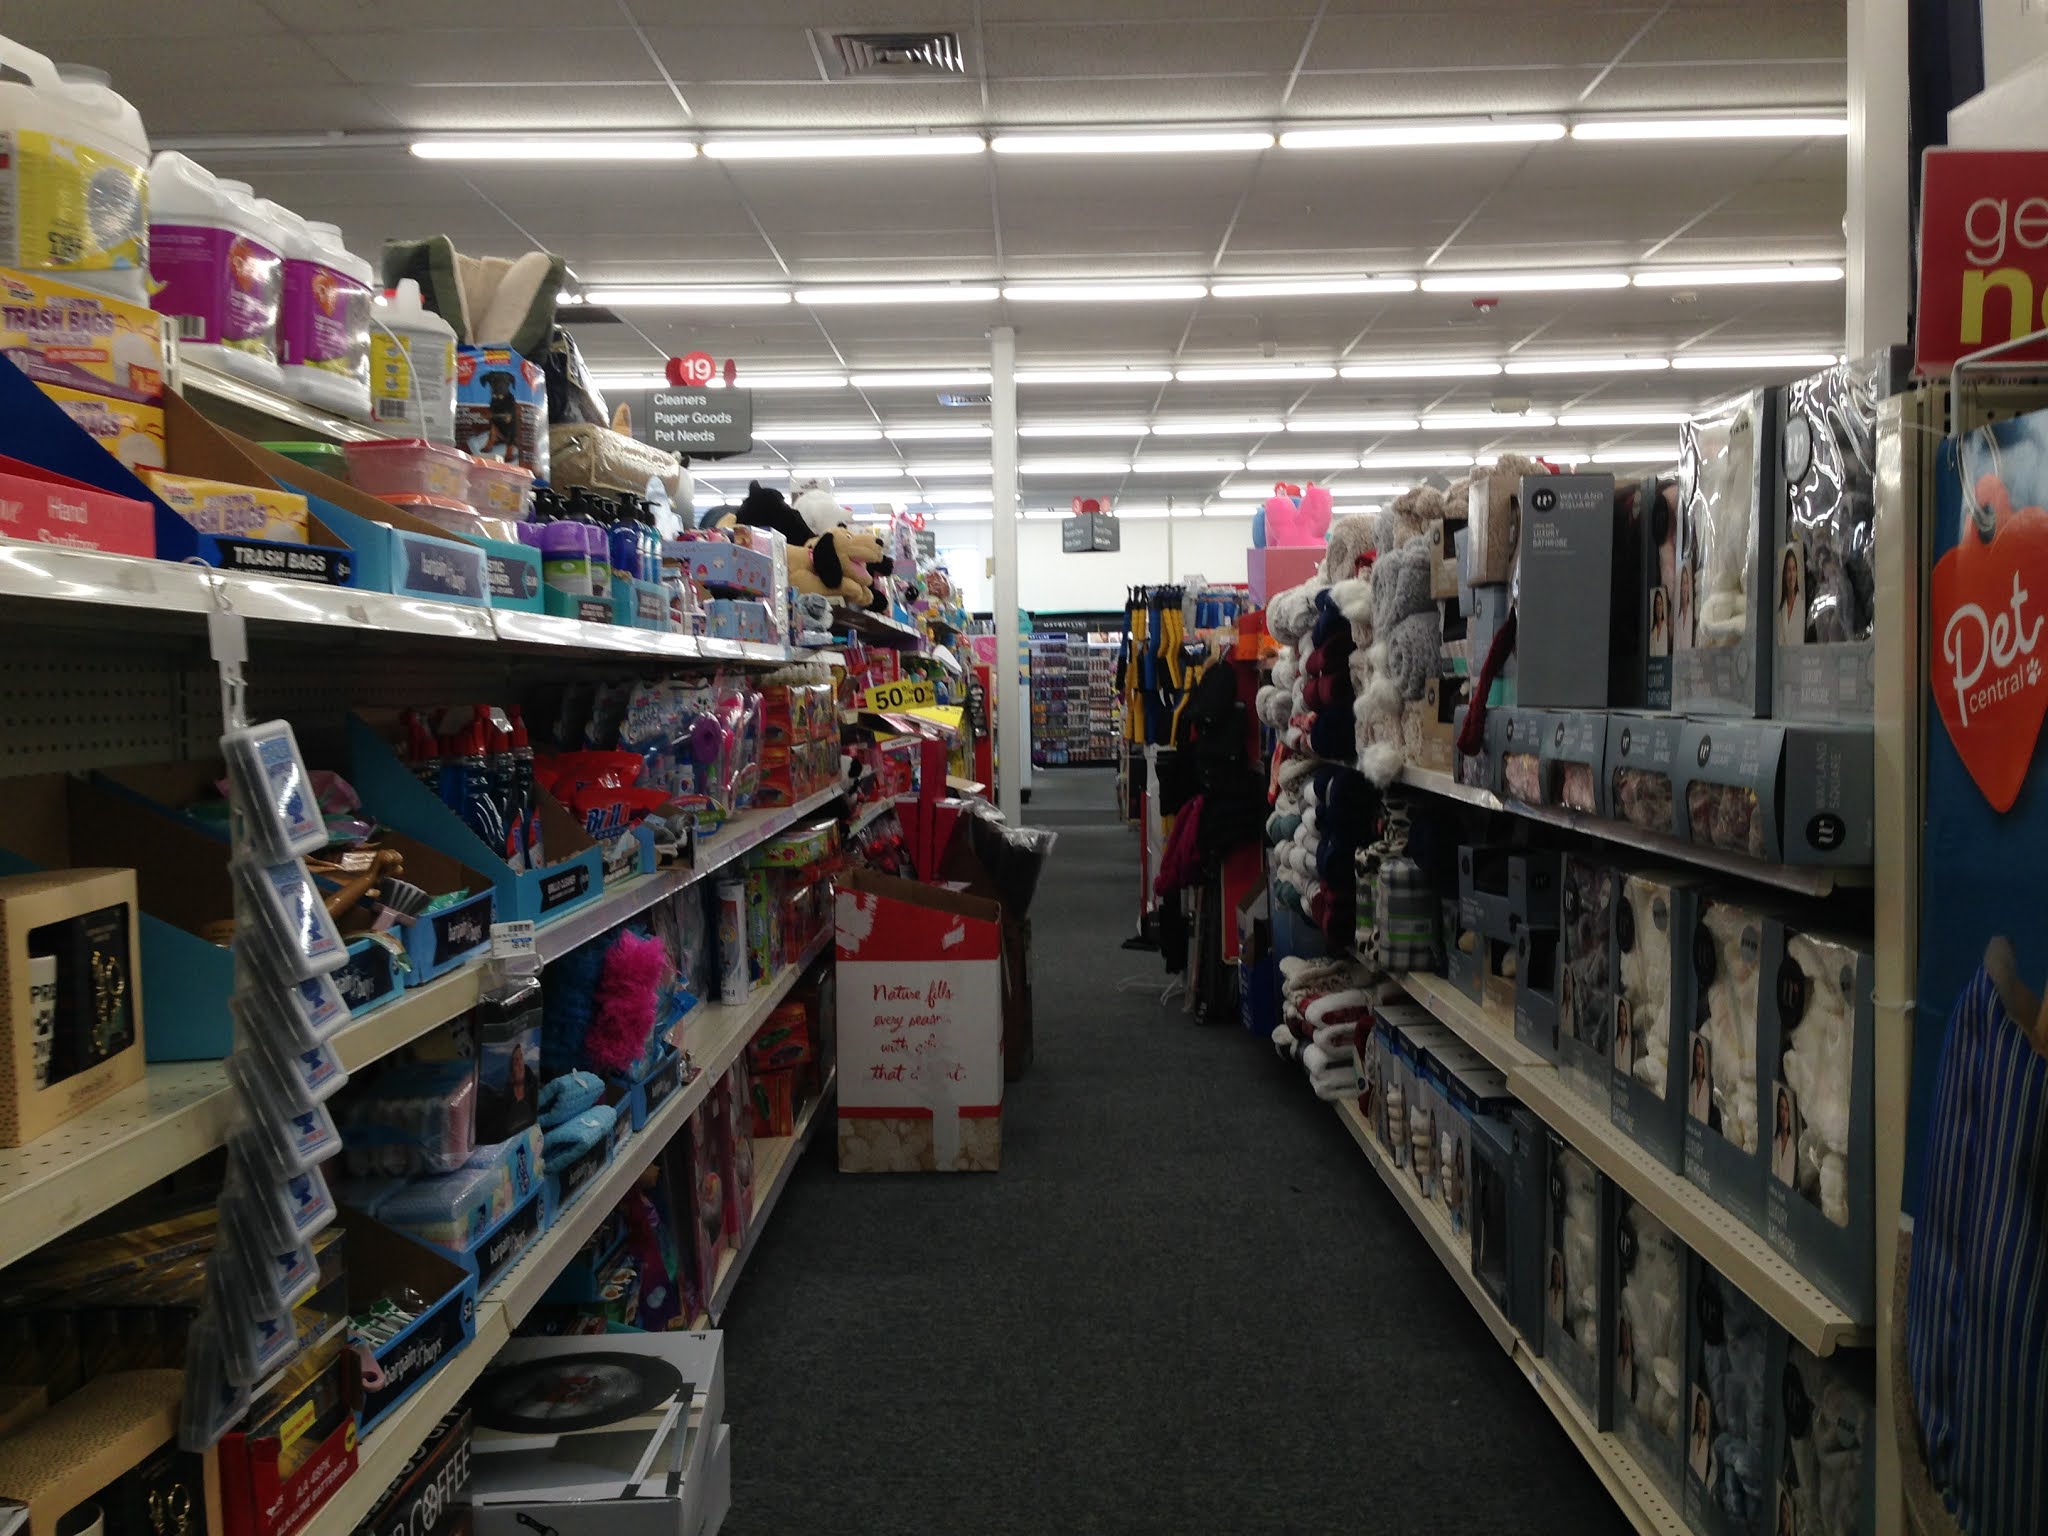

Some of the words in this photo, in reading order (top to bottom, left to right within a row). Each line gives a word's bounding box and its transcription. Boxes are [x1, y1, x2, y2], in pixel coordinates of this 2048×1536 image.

[1960, 267, 2048, 344] n
[2, 304, 62, 331] TRASH
[69, 309, 114, 336] BAGS
[684, 359, 711, 380] 19
[654, 393, 707, 406] Cleaners
[654, 411, 689, 426] Paper
[692, 411, 732, 424] Goods
[655, 430, 675, 442] Pet
[678, 430, 715, 442] Needs
[47, 496, 88, 524] Hand
[233, 546, 286, 569] TRASH
[288, 553, 327, 573] BAGS
[1043, 621, 1088, 629] MAYBELLINE
[1943, 569, 2044, 728] Pet
[1969, 663, 2024, 713] central
[873, 984, 921, 1001] Nature
[924, 979, 954, 1009] fills
[873, 1015, 904, 1033] every
[881, 1036, 908, 1053] with
[870, 1064, 906, 1082] that
[410, 1437, 471, 1536] COFFEE
